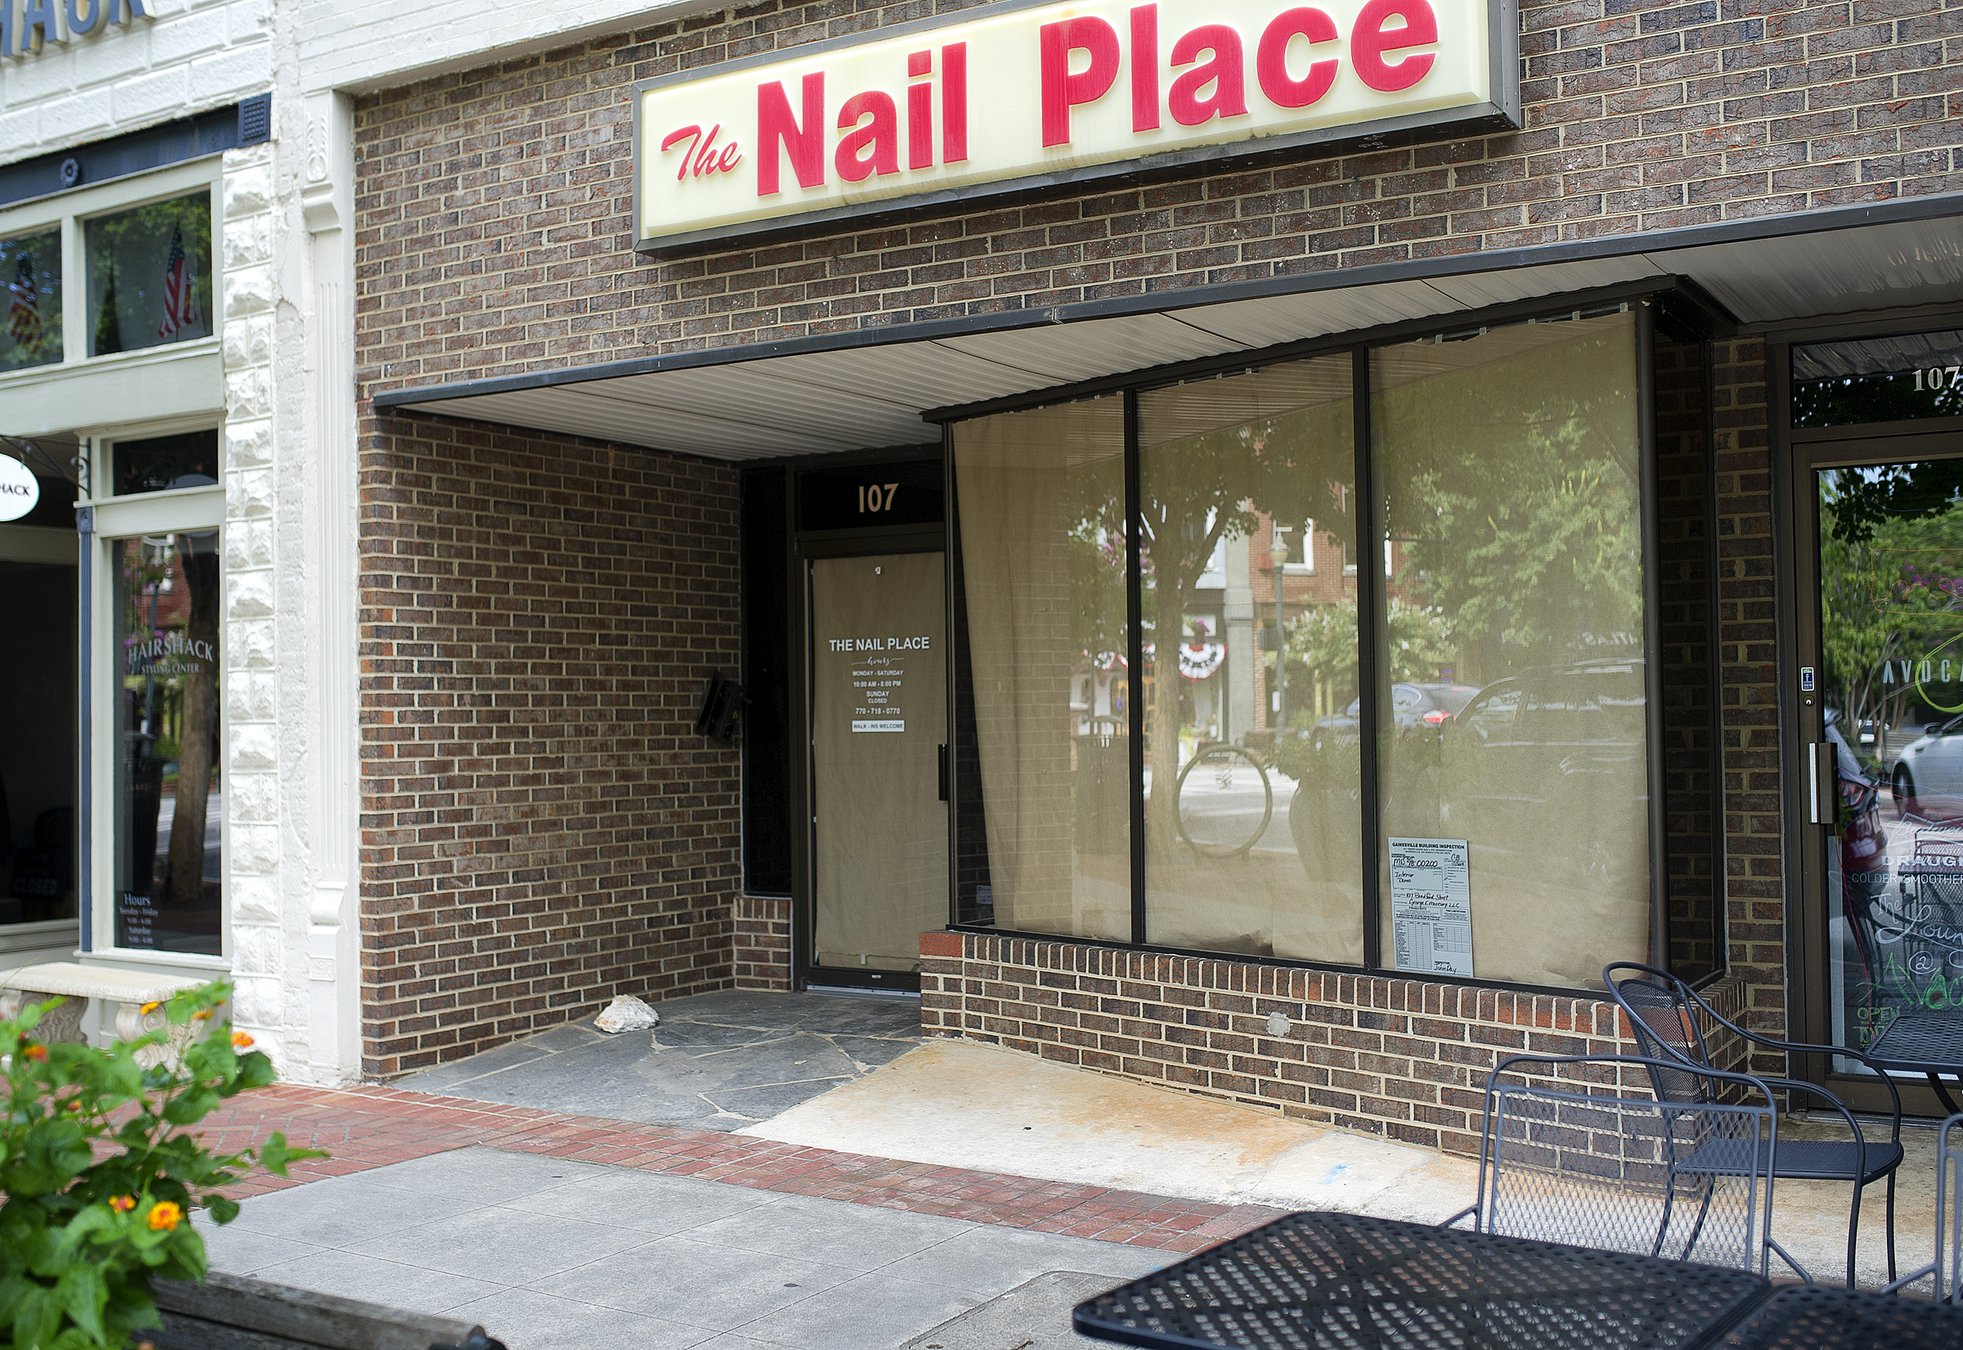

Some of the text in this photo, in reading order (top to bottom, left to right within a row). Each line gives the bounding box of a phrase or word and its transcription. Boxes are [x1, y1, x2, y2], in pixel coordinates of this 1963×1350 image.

[660, 0, 1438, 196] The Nail Place
[858, 483, 899, 512] 107
[128, 637, 214, 664] HAIRSHACK
[829, 636, 930, 652] THE NAIL PLACE
[141, 662, 199, 674] STYLING CENTER
[124, 893, 151, 906] Hours
[1870, 893, 1903, 924] The
[1857, 1006, 1901, 1022] OPEN
